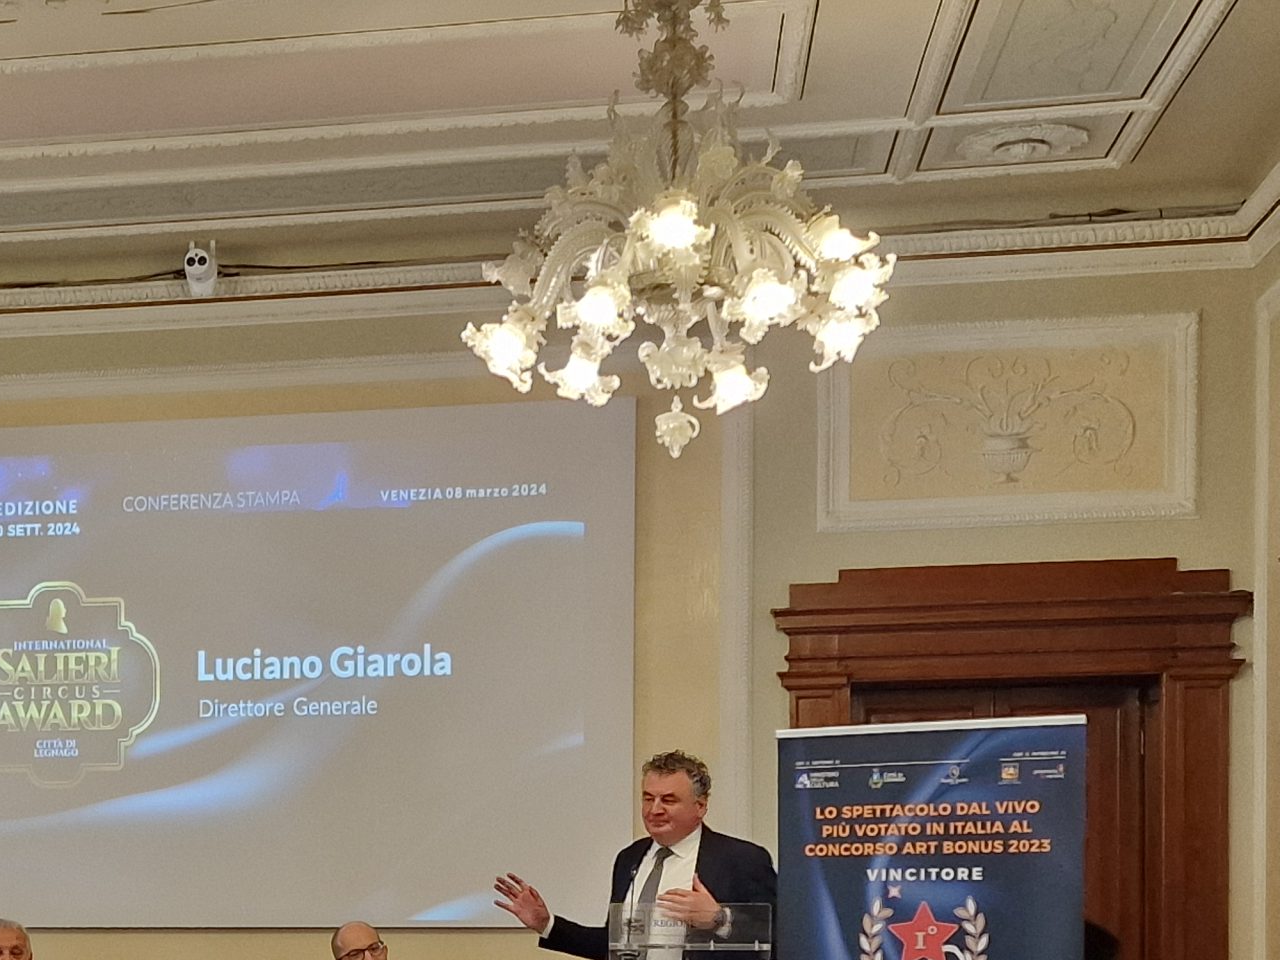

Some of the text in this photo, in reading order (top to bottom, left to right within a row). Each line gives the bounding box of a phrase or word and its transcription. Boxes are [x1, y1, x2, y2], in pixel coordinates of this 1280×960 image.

[380, 484, 547, 501] VENEZIA 08 marzo 2024
[123, 491, 300, 512] CONFERENZA STAMPA
[7, 524, 43, 537] SETT.
[48, 522, 80, 536] 2024
[14, 639, 107, 651] INTERNATIONAL
[197, 643, 452, 681] Luciano Giarola
[13, 686, 100, 700] CIRCUS
[199, 696, 378, 718] Direttore Generale
[66, 739, 76, 748] DI
[34, 749, 78, 757] LEGNAGO
[815, 800, 1040, 820] LO SPETTACOLO DAL VIVO
[822, 820, 1032, 838] PIÙ VOTATO IN ITALIA AL
[805, 839, 1051, 857] CONCORSO ART BONUS 2023
[866, 867, 984, 881] VINCITORE
